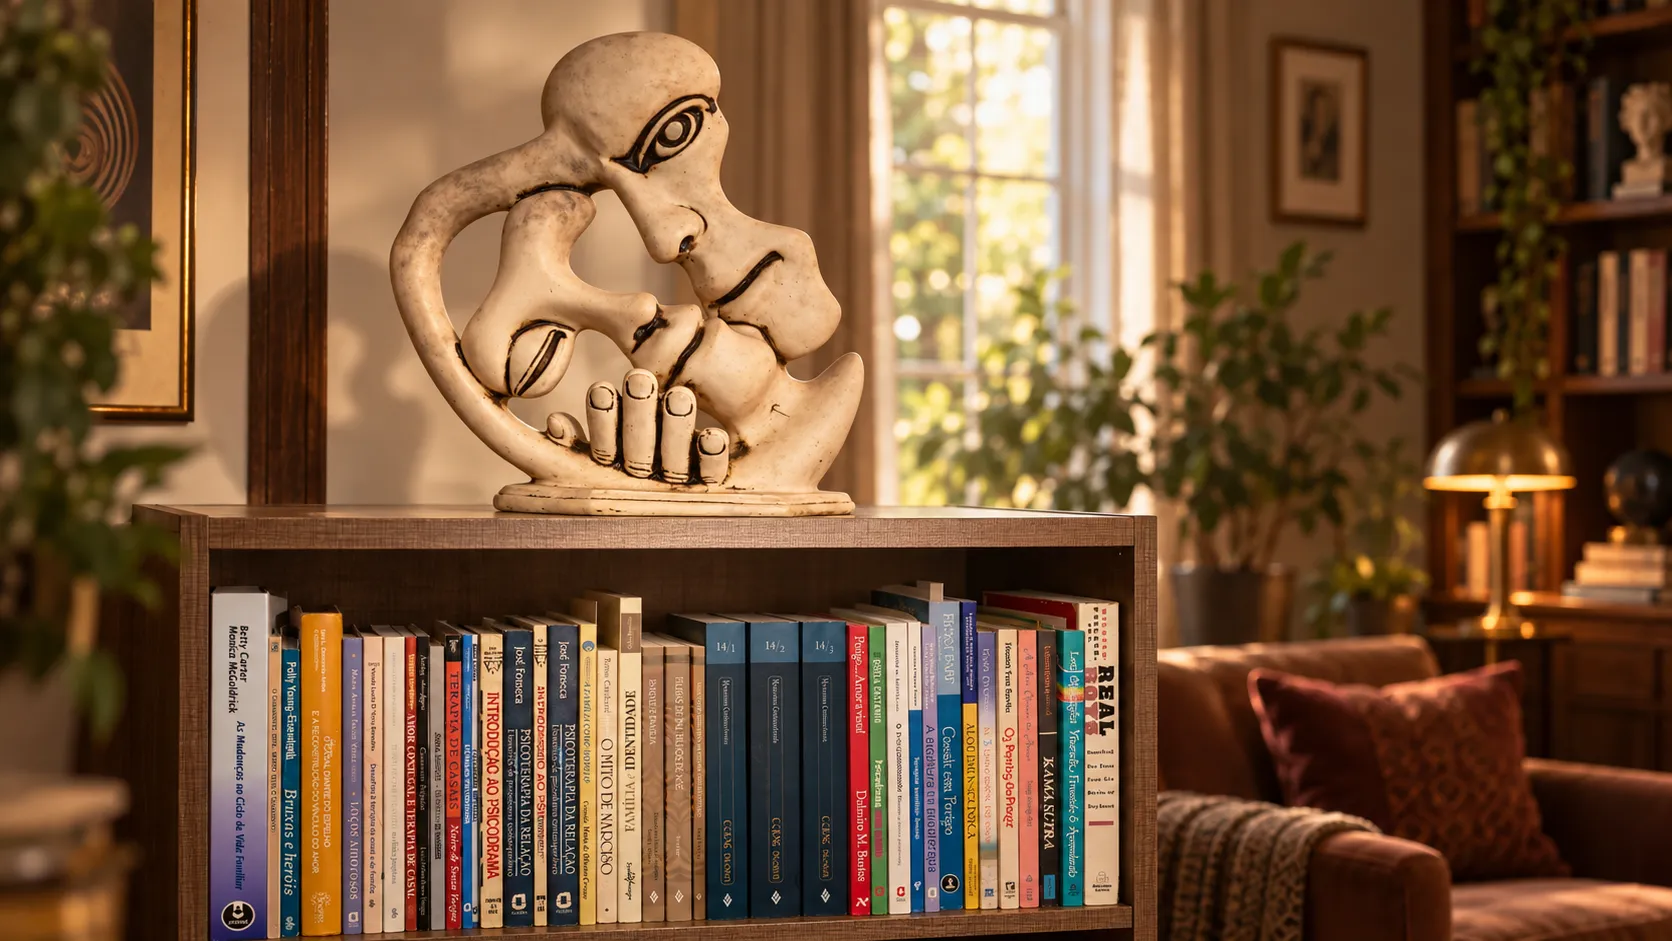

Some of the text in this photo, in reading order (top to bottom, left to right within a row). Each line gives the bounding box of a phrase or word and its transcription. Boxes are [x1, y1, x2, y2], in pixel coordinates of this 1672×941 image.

[238, 626, 249, 683] Betty Carter
[716, 641, 735, 653] 14/1
[765, 640, 785, 653] 14/2
[815, 640, 834, 654] 14/3
[228, 662, 238, 714] McGoldrick
[285, 662, 297, 683] Polly
[1098, 665, 1115, 736] REAL
[237, 721, 245, 732] As
[449, 672, 459, 810] TERAPIA DE CASAIS
[624, 690, 636, 771] IDENTIDADE
[486, 777, 500, 795] AO
[520, 729, 531, 807] PSICOTERAPIA
[564, 724, 576, 803] PSICOTERAPIA
[235, 820, 245, 831] de
[520, 809, 531, 823] DA
[565, 806, 576, 821] DA
[600, 738, 613, 875] O MITO DE NARCISO
[622, 782, 635, 832] FAMÍLIA
[1044, 756, 1055, 850] KAMA SUTRA
[486, 799, 500, 879] PSICODRAMA
[857, 833, 867, 848] M.
